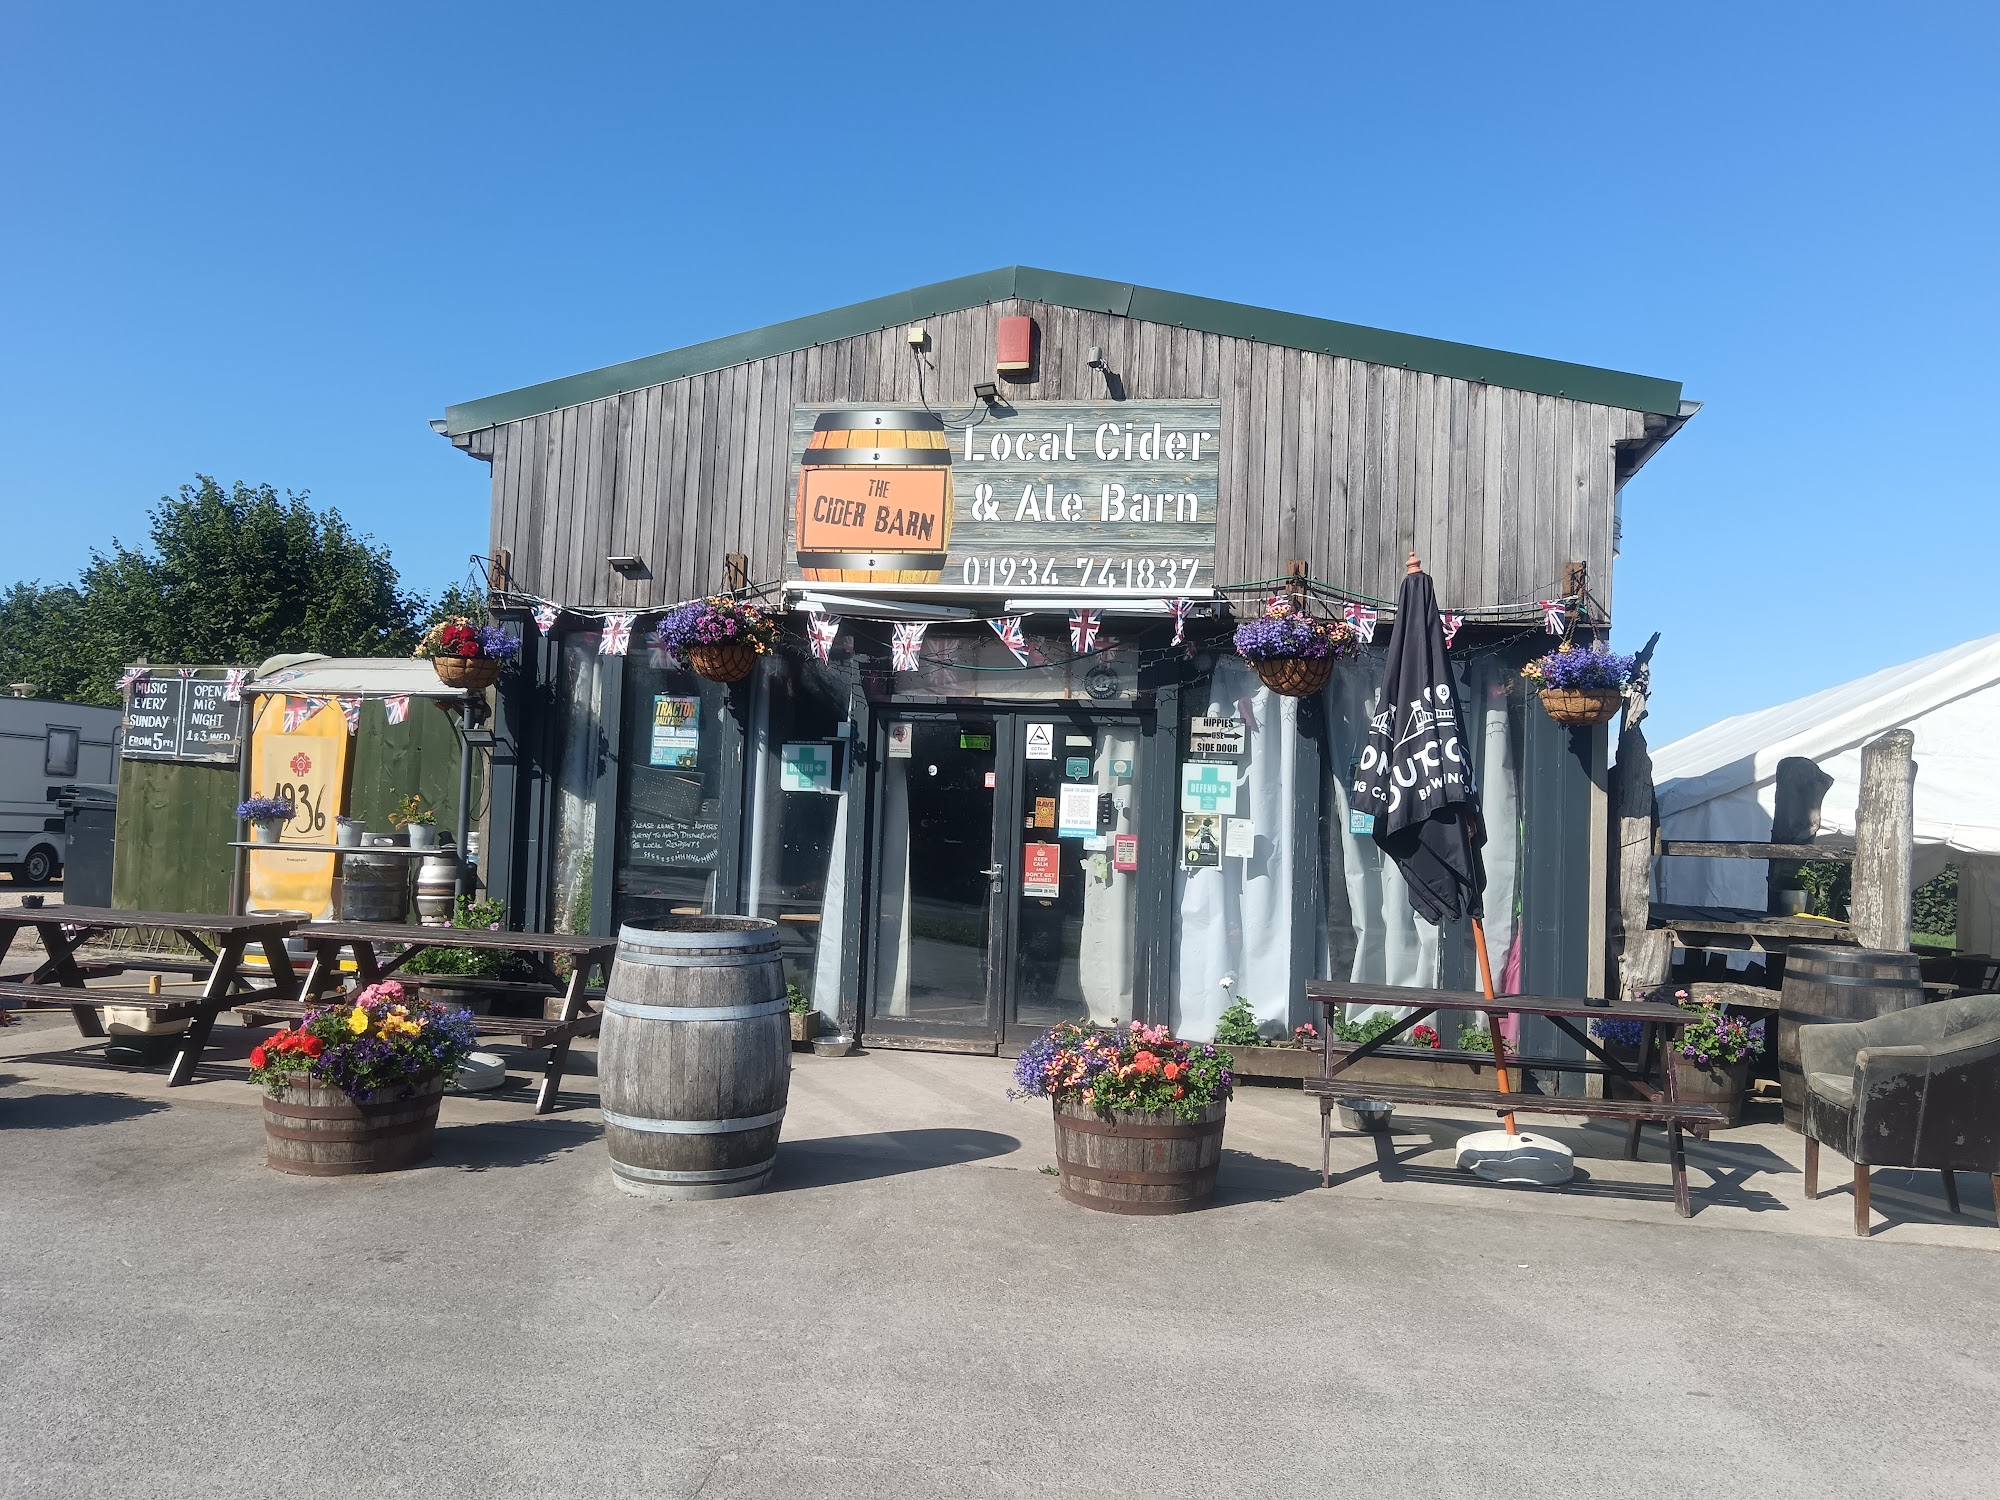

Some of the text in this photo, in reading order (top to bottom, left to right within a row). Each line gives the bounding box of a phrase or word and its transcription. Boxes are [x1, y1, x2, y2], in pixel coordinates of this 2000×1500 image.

[964, 422, 1212, 461] Local Cider
[868, 478, 891, 498] THE
[971, 483, 1199, 522] & Ale Barn
[813, 495, 935, 541] CIDER BARN
[963, 556, 1200, 589] 01934 741837
[135, 682, 168, 694] MUSIC
[194, 685, 223, 697] OPEN
[134, 697, 168, 711] EVERY
[193, 699, 217, 711] MIC
[655, 701, 697, 717] TRACTOR
[129, 713, 170, 729] SUNDAY
[191, 713, 225, 726] NIGHT
[1203, 718, 1234, 728] HIPPIES
[128, 735, 152, 748] FROM
[1211, 731, 1224, 740] USE
[1197, 743, 1238, 752] SIDE DOOR
[1190, 783, 1217, 794] DEFEND
